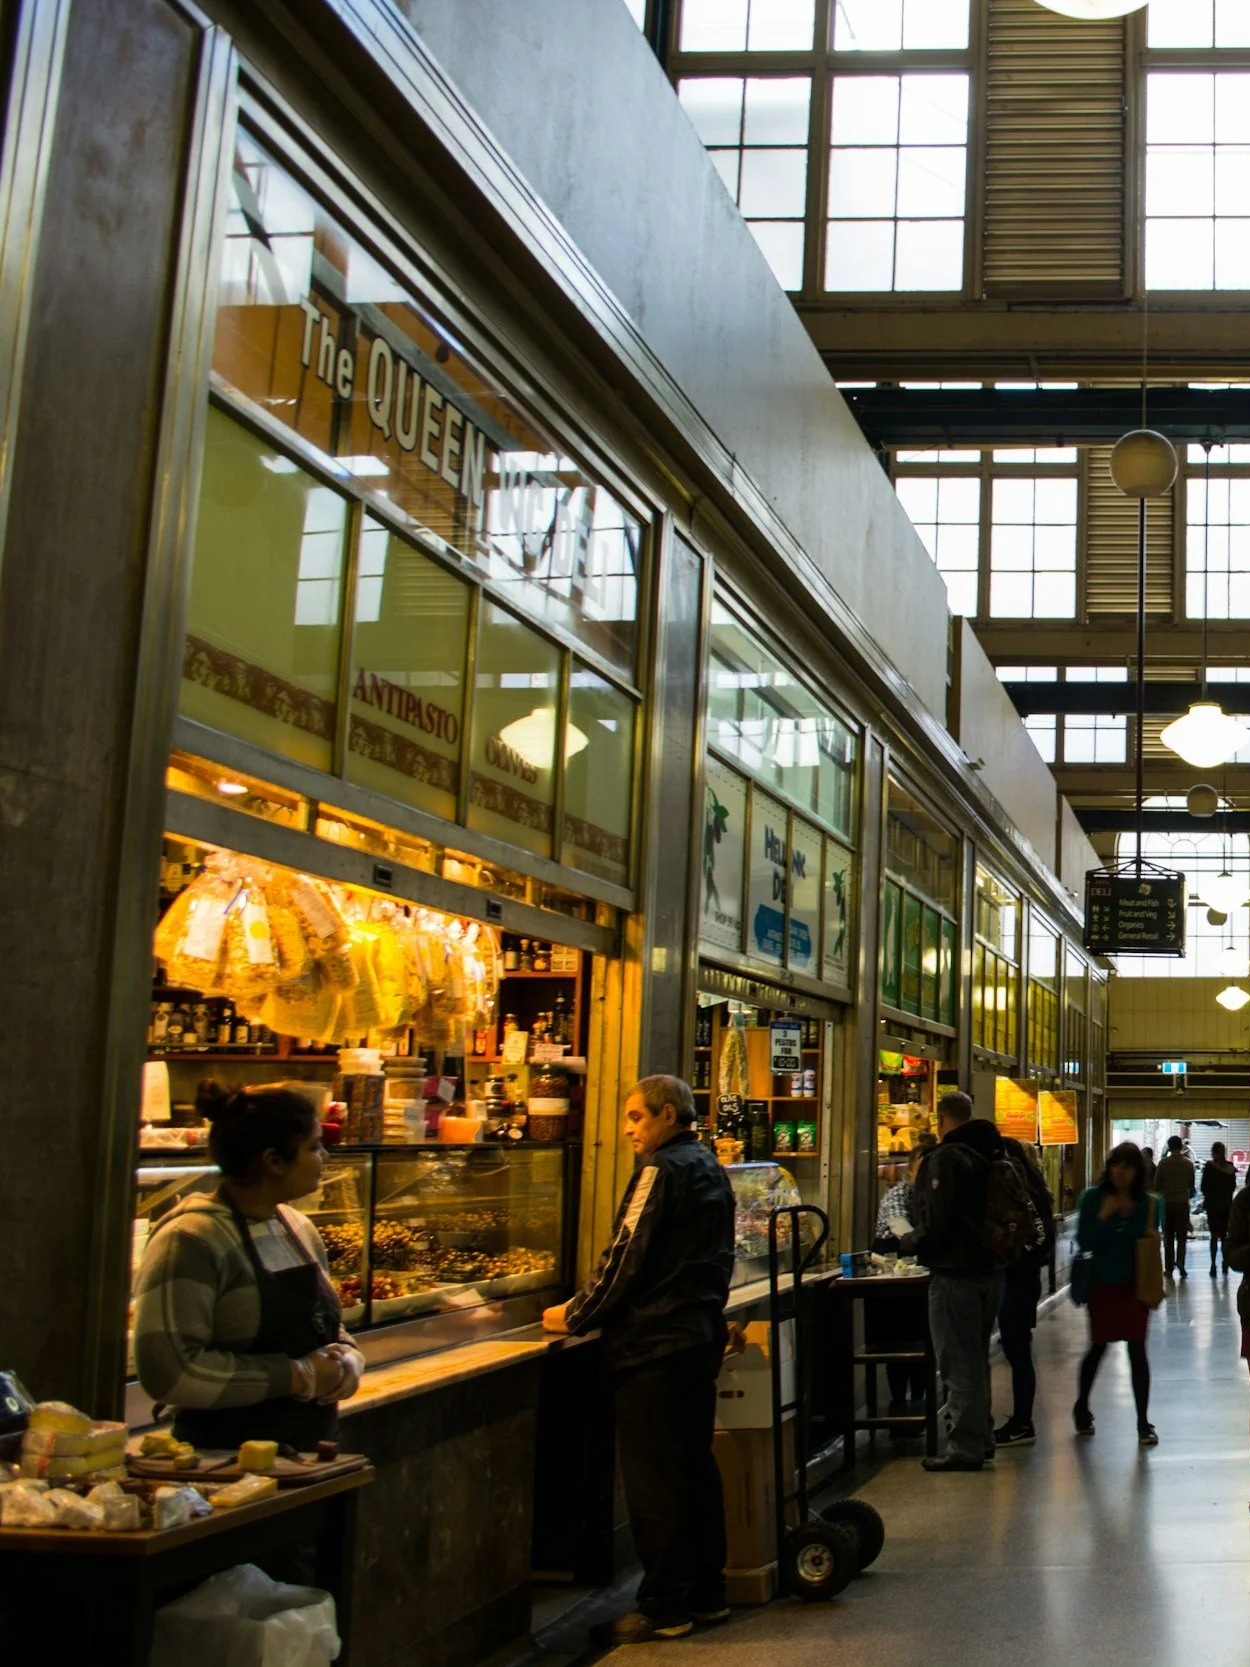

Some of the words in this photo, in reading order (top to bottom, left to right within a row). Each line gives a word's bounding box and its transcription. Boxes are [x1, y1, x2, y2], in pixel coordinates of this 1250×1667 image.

[299, 294, 354, 402] The
[367, 336, 488, 509] QUEEN
[353, 667, 459, 746] ANTIPASTO
[775, 1039, 797, 1047] PESTOS
[781, 1047, 792, 1055] FOR
